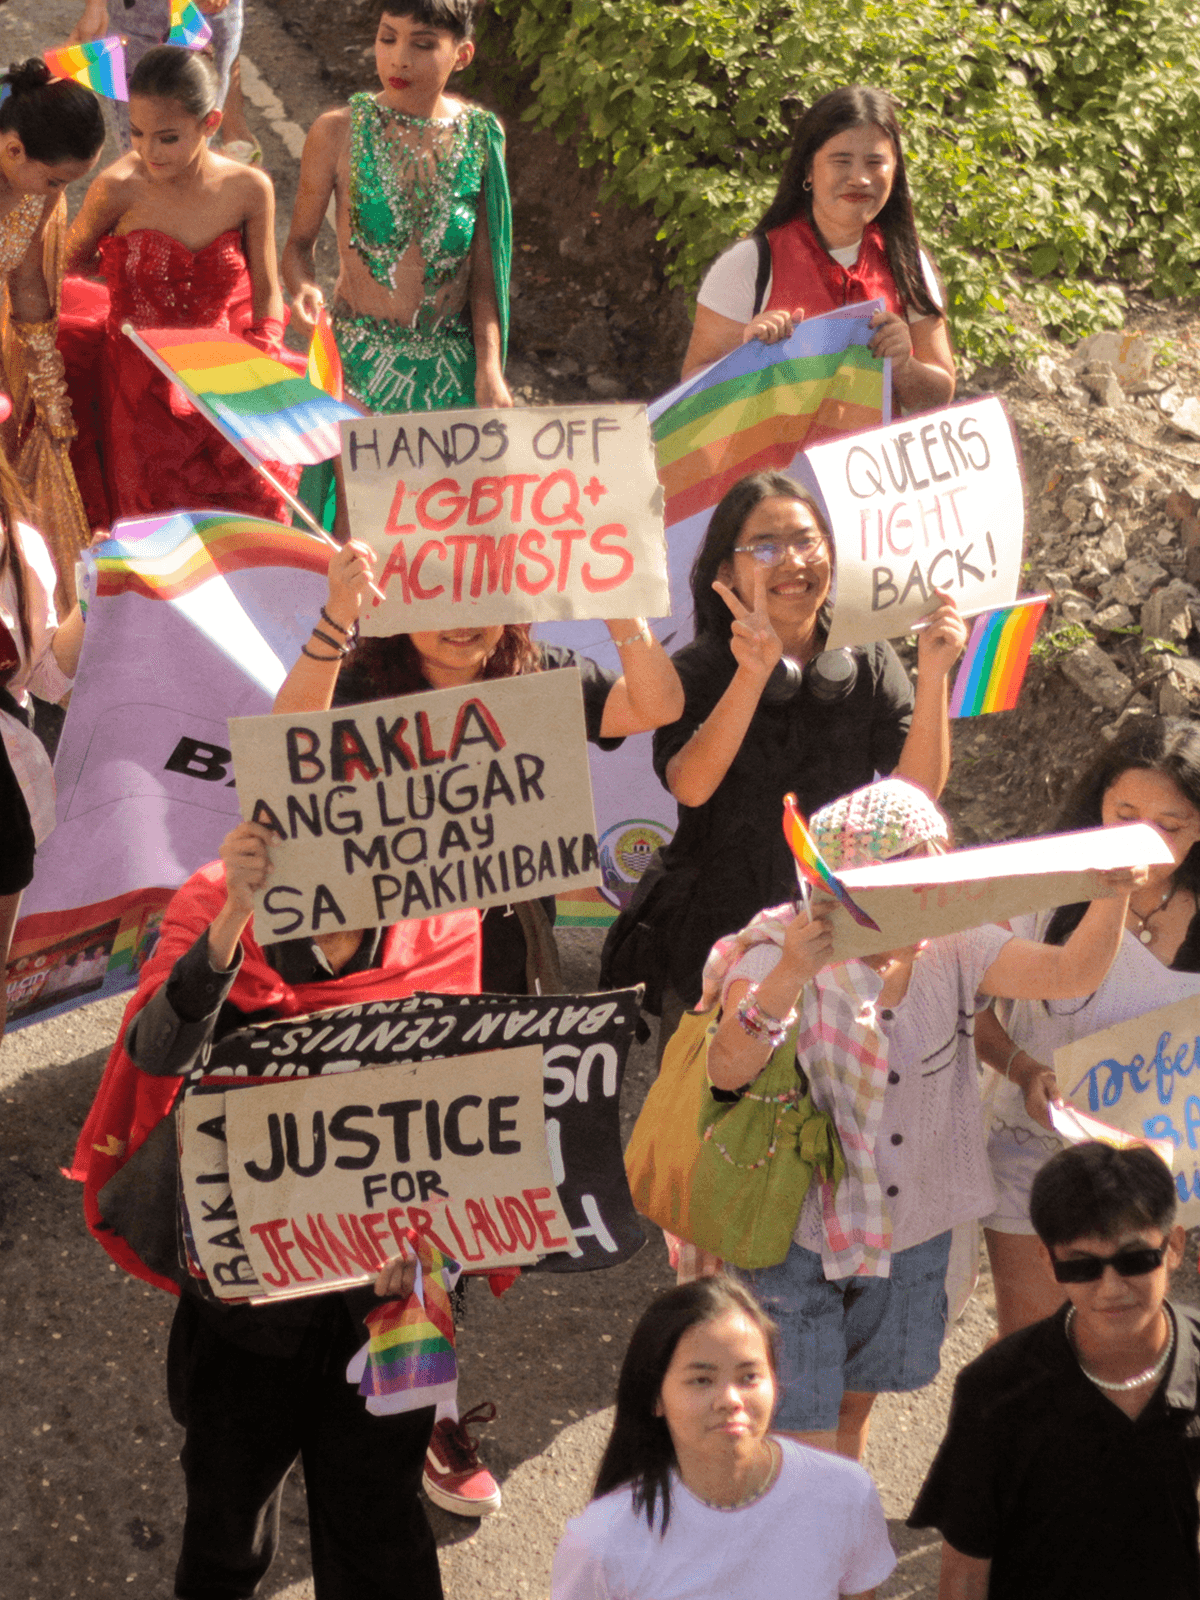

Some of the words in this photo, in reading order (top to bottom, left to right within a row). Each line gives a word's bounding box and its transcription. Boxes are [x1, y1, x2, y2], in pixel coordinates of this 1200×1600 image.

[349, 418, 510, 472] HANDS
[532, 417, 621, 465] OFF
[845, 417, 991, 499] QUEERS
[384, 468, 609, 535] LGBTQ+
[372, 523, 635, 607] ACTIVISTS
[871, 531, 998, 611] BACK!
[285, 697, 507, 785] BAKLA
[251, 785, 364, 841] ANG
[376, 752, 545, 827] LUGAR
[263, 884, 347, 936] SA
[372, 833, 601, 921] PAKIKIBAKA
[343, 827, 428, 875] MO
[244, 1095, 522, 1183] JUSTICE
[362, 1170, 449, 1208] FOR
[445, 1186, 569, 1262] LAUDE
